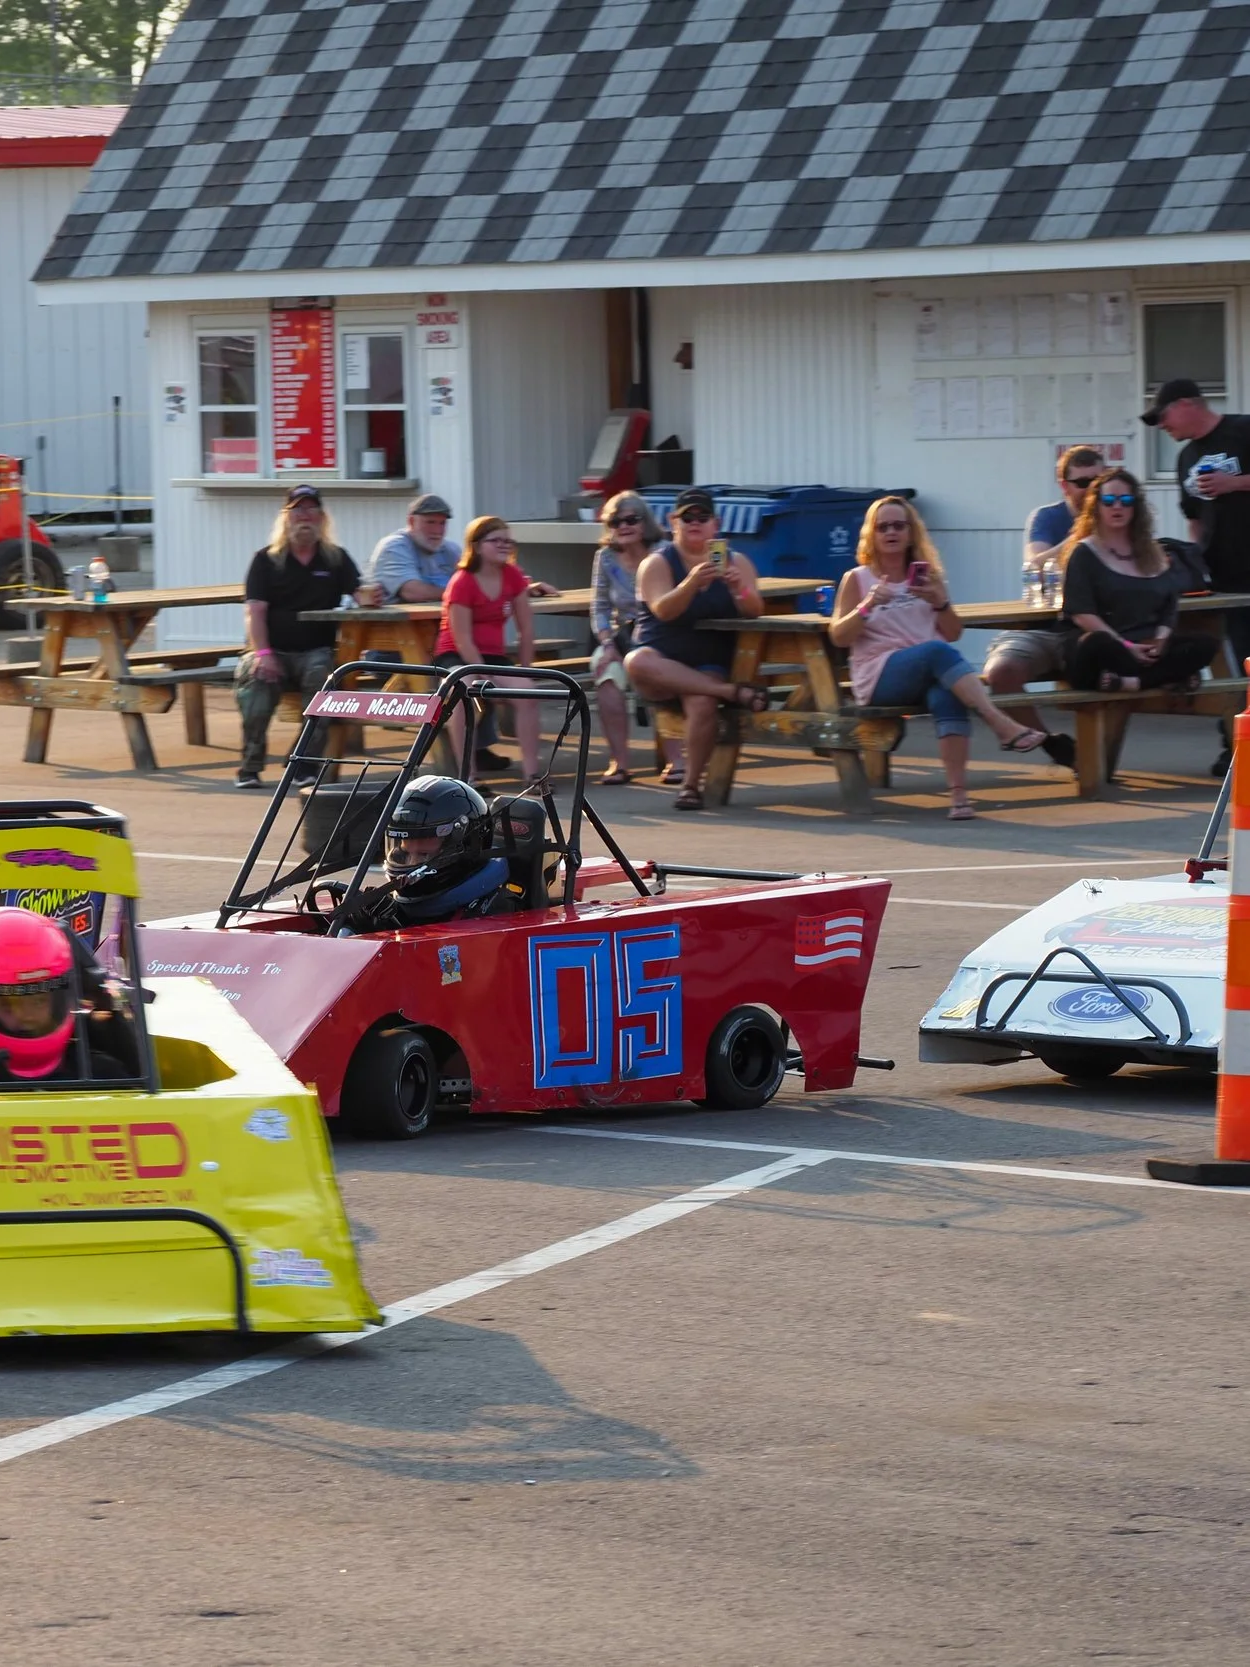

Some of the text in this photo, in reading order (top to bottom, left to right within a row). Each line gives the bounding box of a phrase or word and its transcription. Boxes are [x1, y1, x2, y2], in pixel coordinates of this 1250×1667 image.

[316, 695, 429, 717] Austin McCallum
[386, 829, 409, 839] zamp
[146, 959, 199, 975] Special
[198, 961, 251, 975] Thanks
[527, 923, 684, 1090] 05
[1068, 990, 1125, 1016] Ford
